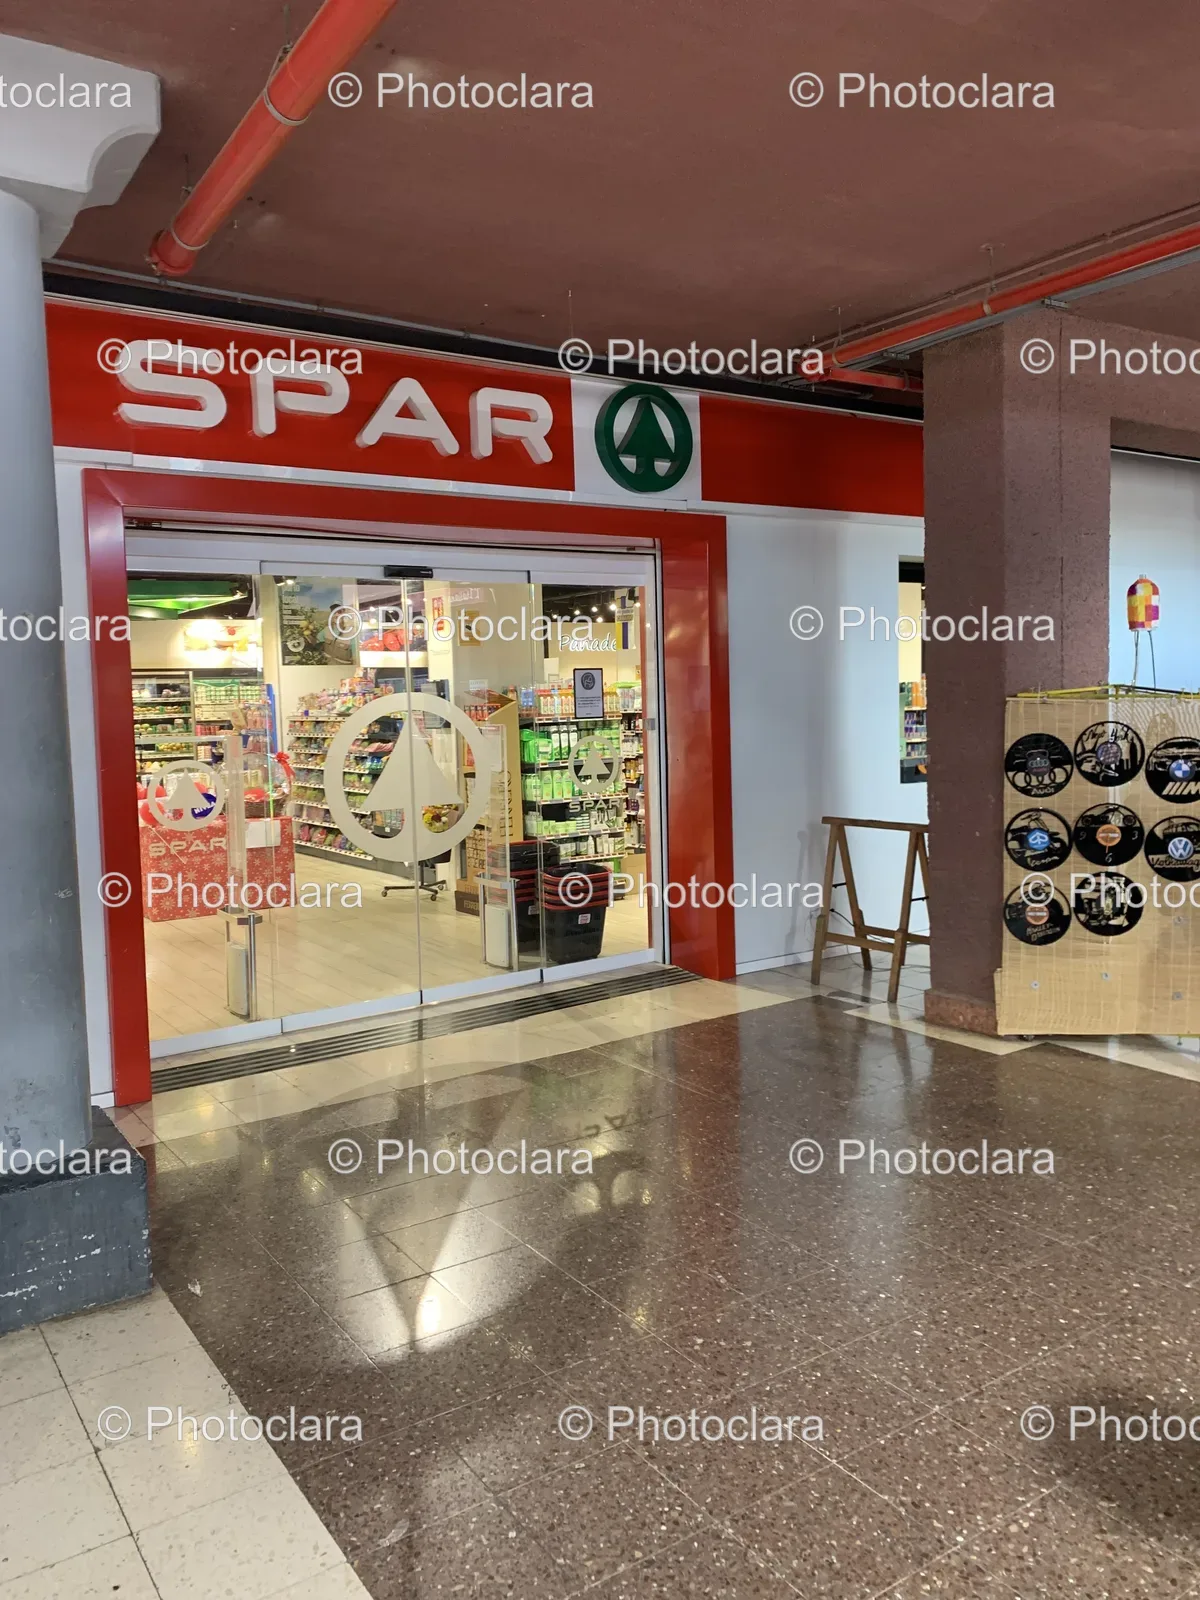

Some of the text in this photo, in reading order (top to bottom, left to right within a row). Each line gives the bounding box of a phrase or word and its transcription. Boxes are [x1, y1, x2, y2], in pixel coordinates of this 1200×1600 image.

[116, 339, 554, 465] SPAR
[568, 797, 621, 813] SPAR
[148, 836, 227, 858] SPAR
